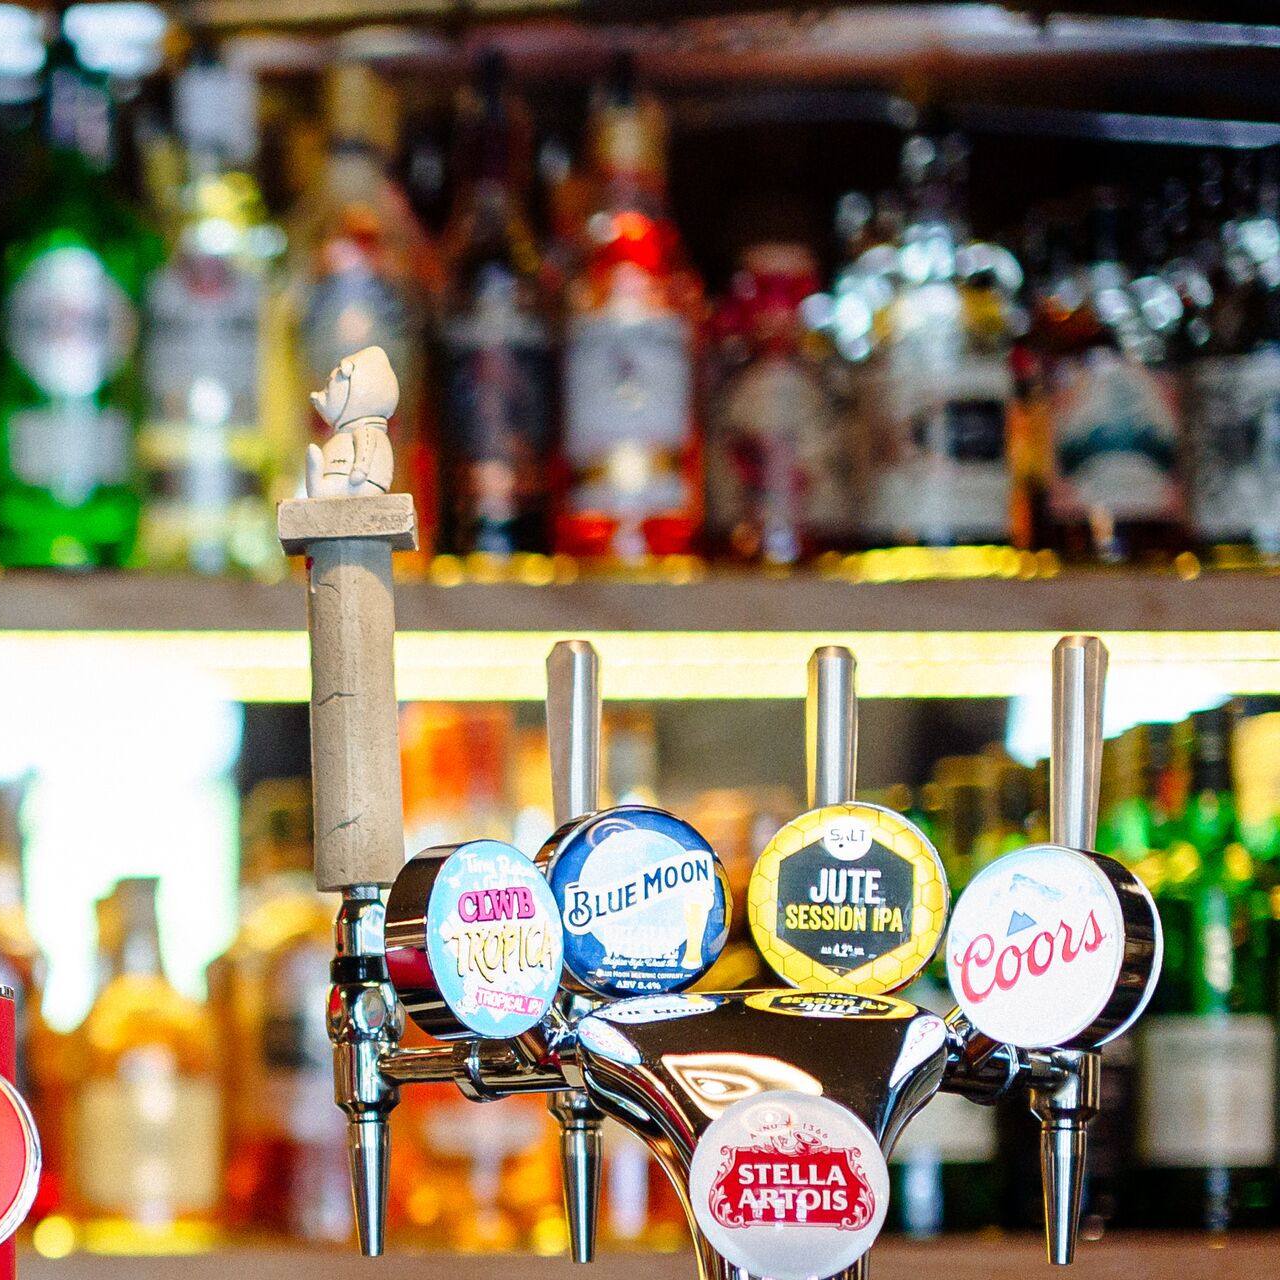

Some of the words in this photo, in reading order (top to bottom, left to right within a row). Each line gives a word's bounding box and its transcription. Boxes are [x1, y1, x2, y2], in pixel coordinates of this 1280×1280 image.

[568, 882, 637, 927] BLUE
[643, 859, 709, 900] MOON
[810, 868, 881, 904] JUTE
[458, 887, 535, 922] CLWB
[785, 904, 866, 932] SESSION
[872, 907, 903, 932] IPA
[444, 920, 553, 983] TROPICA
[953, 909, 1107, 1004] Coors
[738, 1164, 847, 1186] STELLA
[738, 1188, 848, 1210] ARTOIS
